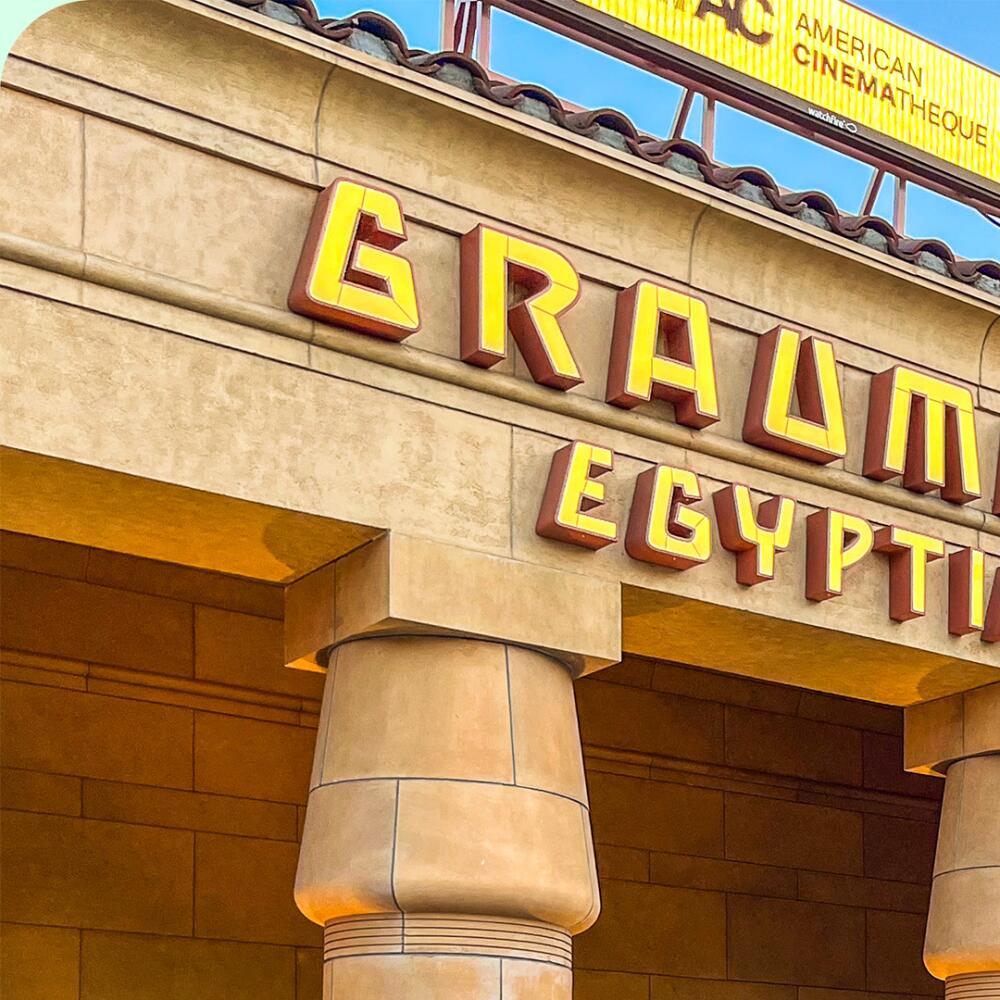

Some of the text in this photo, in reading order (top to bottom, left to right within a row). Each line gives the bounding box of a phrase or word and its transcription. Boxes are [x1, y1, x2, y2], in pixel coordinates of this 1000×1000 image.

[795, 13, 923, 88] AMERICAN
[793, 42, 988, 148] CINEMATHEQUE
[808, 106, 846, 130] watchfire
